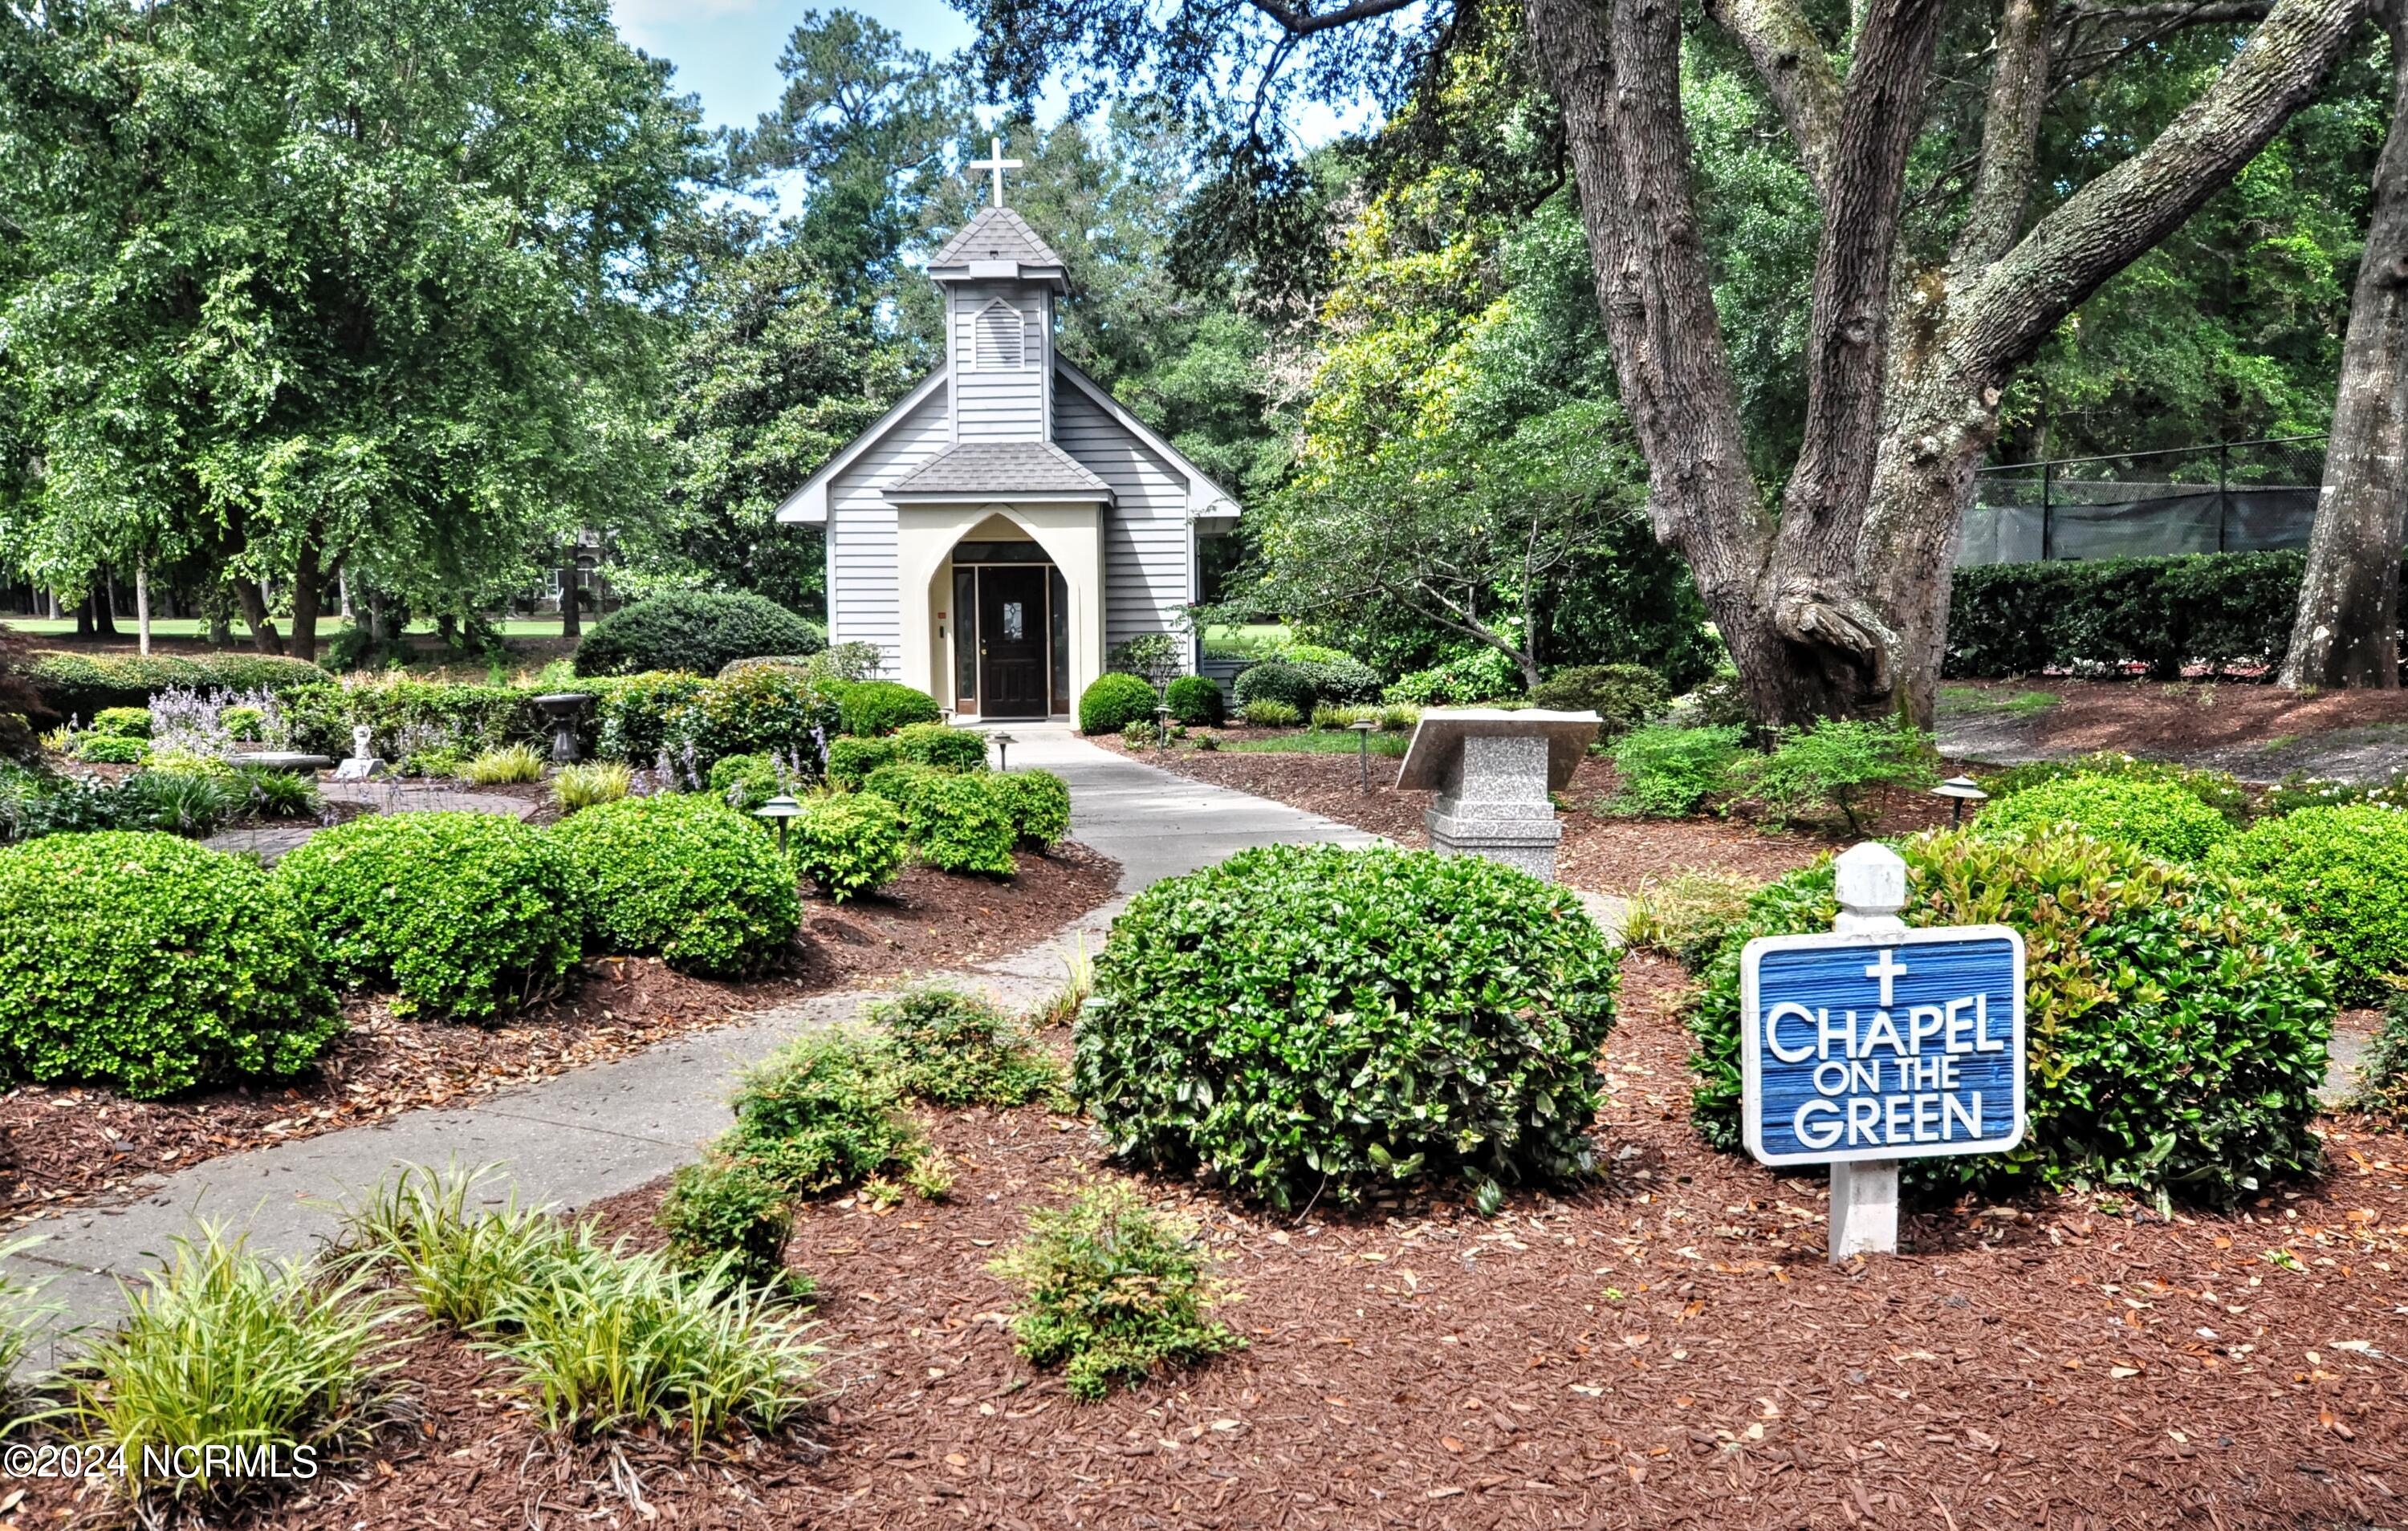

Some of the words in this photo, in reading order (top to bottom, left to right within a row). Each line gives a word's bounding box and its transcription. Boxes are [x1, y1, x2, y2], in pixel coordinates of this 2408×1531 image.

[1766, 993, 2004, 1063] CHAPEL
[1812, 1059, 1880, 1096] ON
[1894, 1055, 1960, 1091] THE
[1793, 1091, 1982, 1149] GREEN
